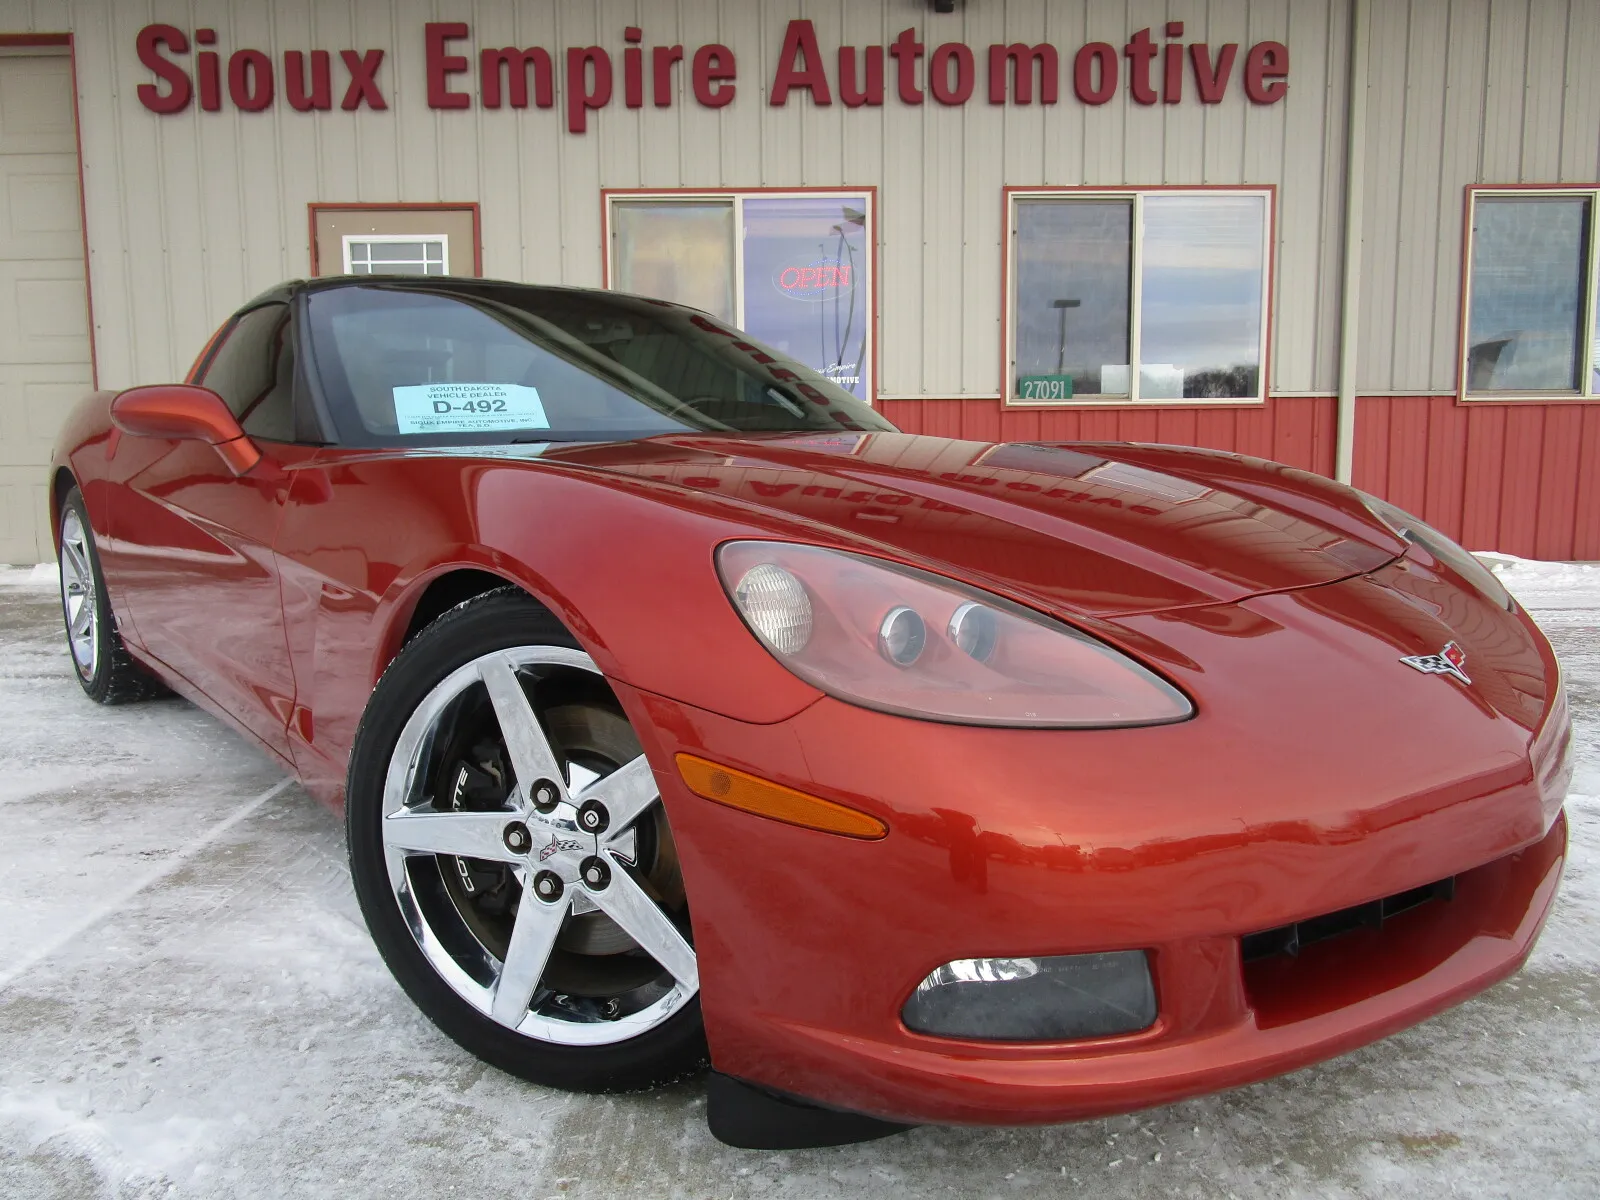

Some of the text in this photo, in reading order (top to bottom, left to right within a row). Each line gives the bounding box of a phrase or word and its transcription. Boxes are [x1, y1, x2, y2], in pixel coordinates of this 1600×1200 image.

[136, 19, 1289, 133] Sioux Empire Automotive
[780, 265, 851, 289] OPEN
[1024, 380, 1065, 399] 27091
[432, 399, 507, 414] D-492
